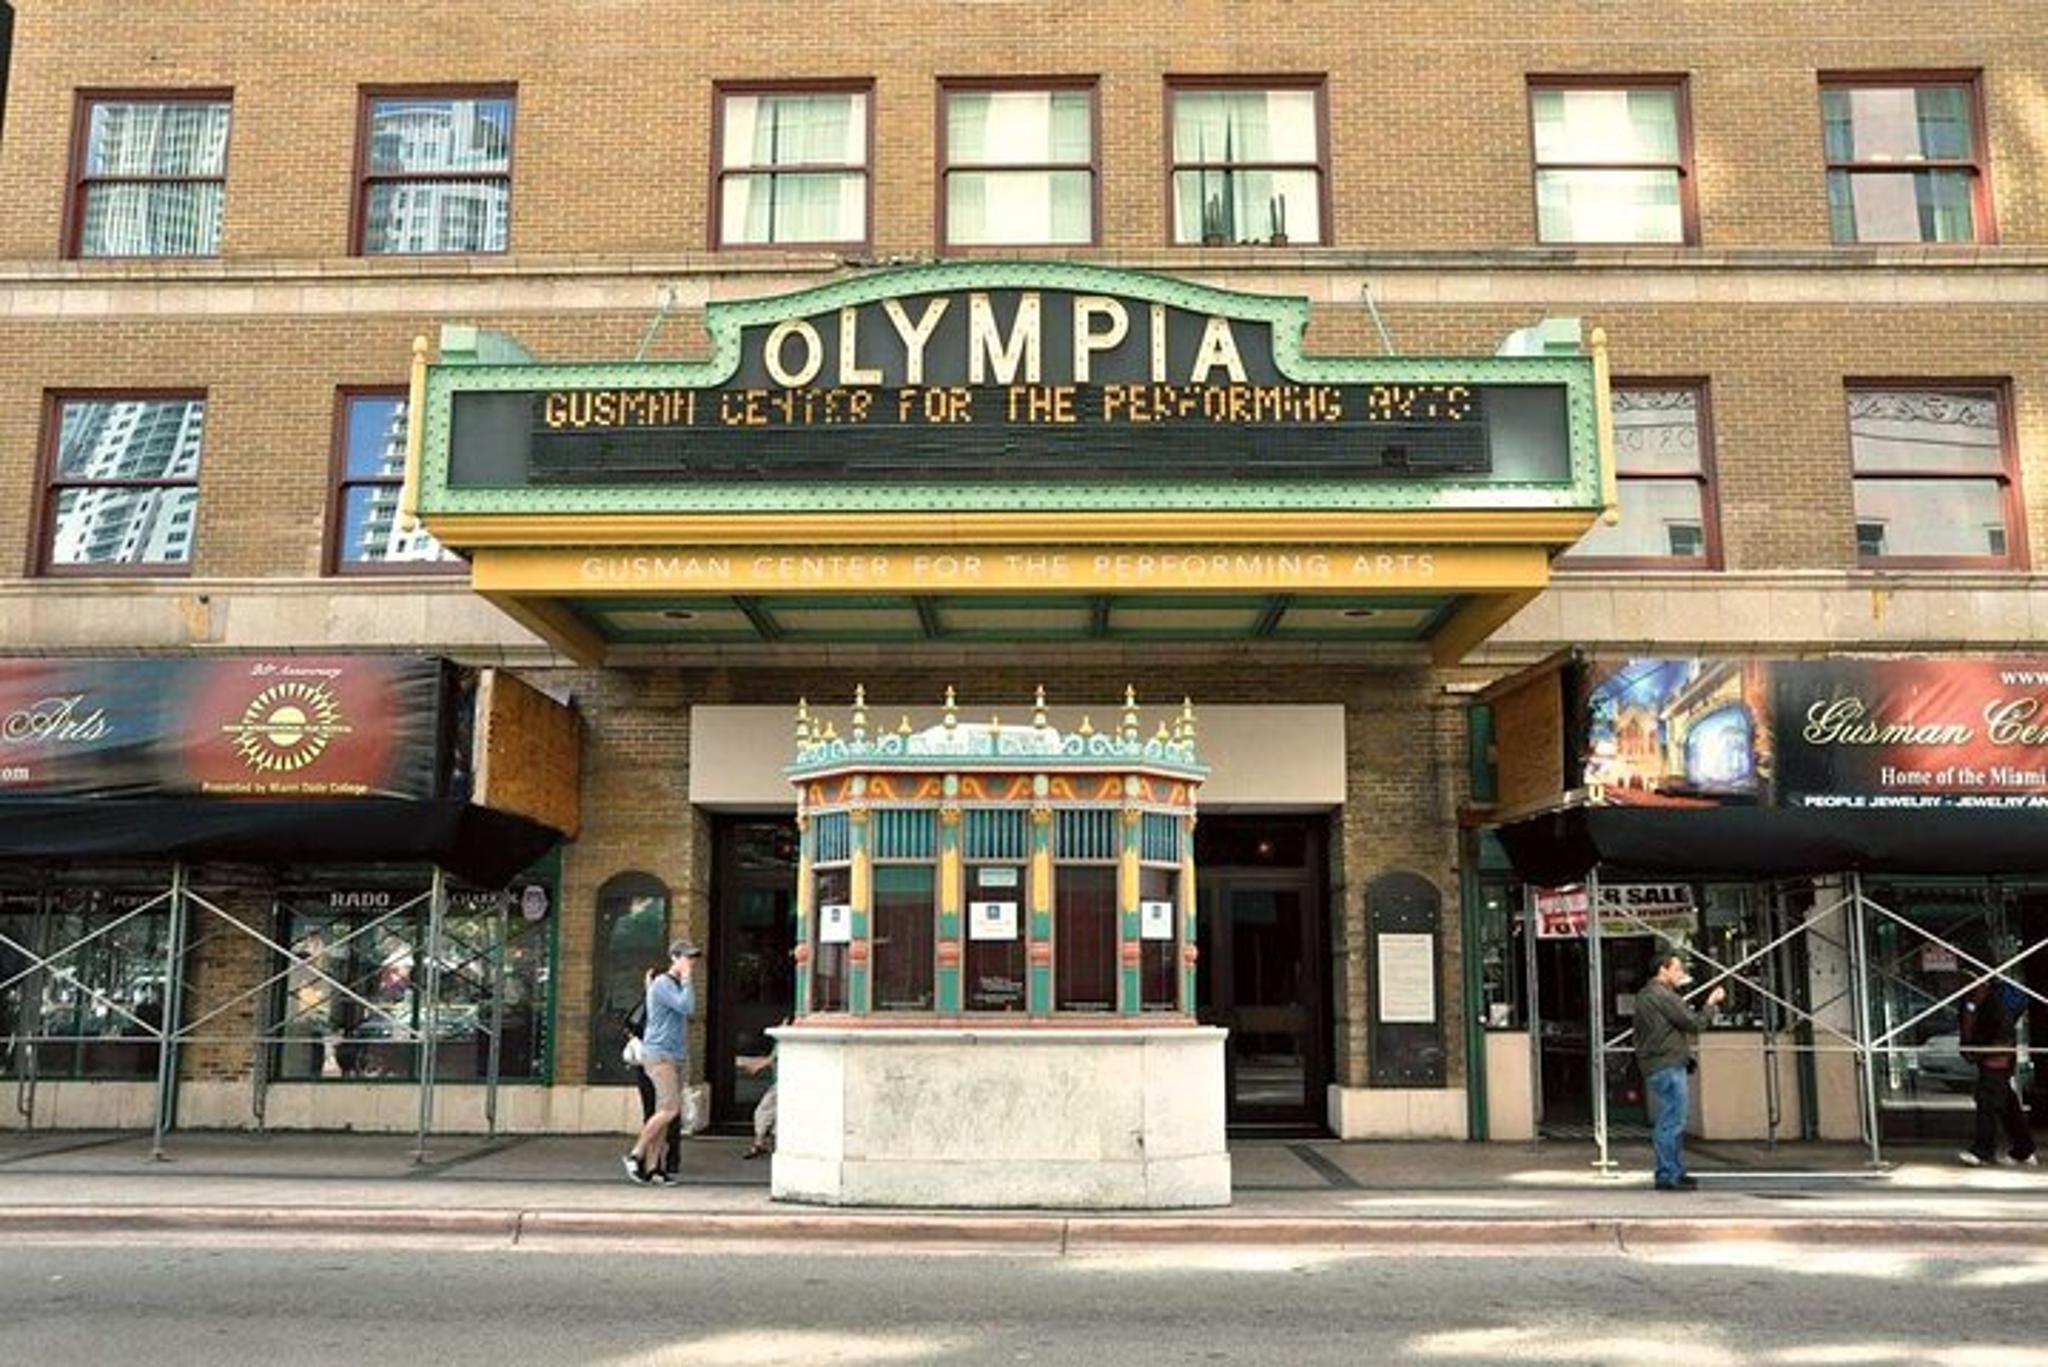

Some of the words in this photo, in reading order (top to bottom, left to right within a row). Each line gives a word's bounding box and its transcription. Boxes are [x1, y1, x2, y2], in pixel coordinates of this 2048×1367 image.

[764, 292, 1249, 386] OLYMPIA
[546, 391, 695, 428] GUSMAN
[899, 387, 972, 423] FOR
[1007, 386, 1077, 422] THE
[580, 556, 730, 580] GUSMAN
[752, 556, 891, 579] CENTER
[912, 555, 983, 578] FOR
[1004, 555, 1070, 578] THE
[1092, 554, 1330, 578] PERFORMING
[1353, 554, 1436, 578] ARTS
[2, 694, 115, 742] Arts
[1802, 697, 1974, 745] Gusman
[1881, 766, 1932, 785] Home
[1936, 766, 1954, 785] of
[1958, 767, 1986, 785] the
[1990, 766, 2046, 786] Miami
[1804, 796, 1866, 808] PEOPLE
[1869, 796, 1941, 808] JEWELRY
[1956, 796, 2026, 808] JEWELRY
[330, 891, 391, 907] RADO
